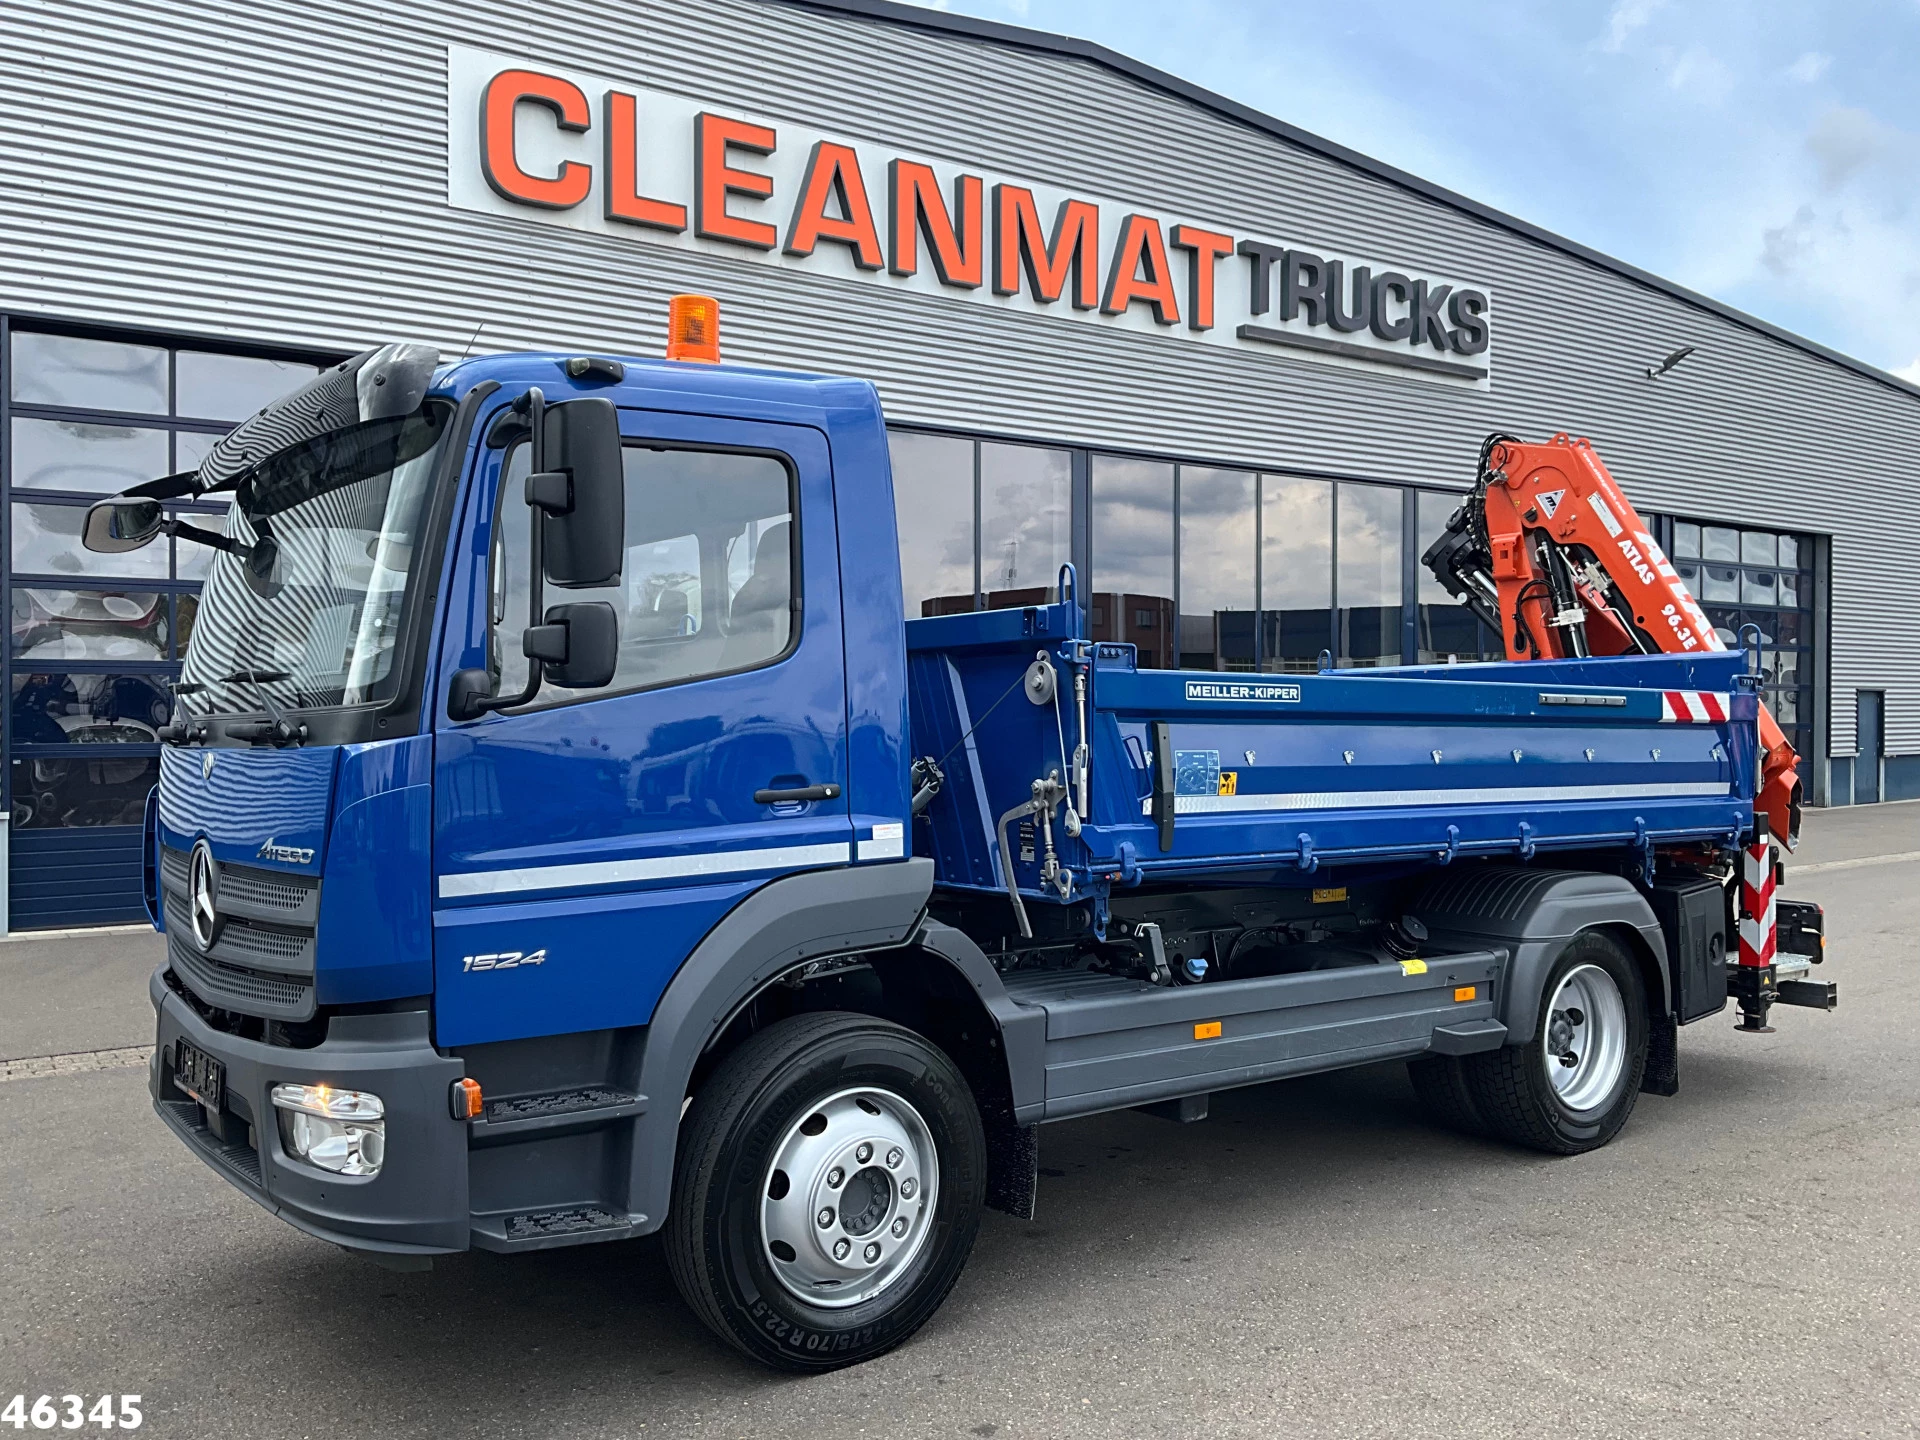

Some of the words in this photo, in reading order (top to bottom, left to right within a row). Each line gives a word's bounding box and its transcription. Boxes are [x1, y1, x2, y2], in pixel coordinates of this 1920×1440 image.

[480, 68, 1234, 331] CLEANMAT
[1237, 239, 1489, 356] TRUCKS
[1617, 539, 1655, 585] ATLAS
[1661, 604, 1698, 651] 96.3E
[1188, 685, 1298, 699] MEILLER-KIPPER
[463, 949, 546, 973] 1524
[752, 1301, 790, 1338] 22.5
[789, 1328, 805, 1347] R
[806, 1328, 873, 1352] 275/70
